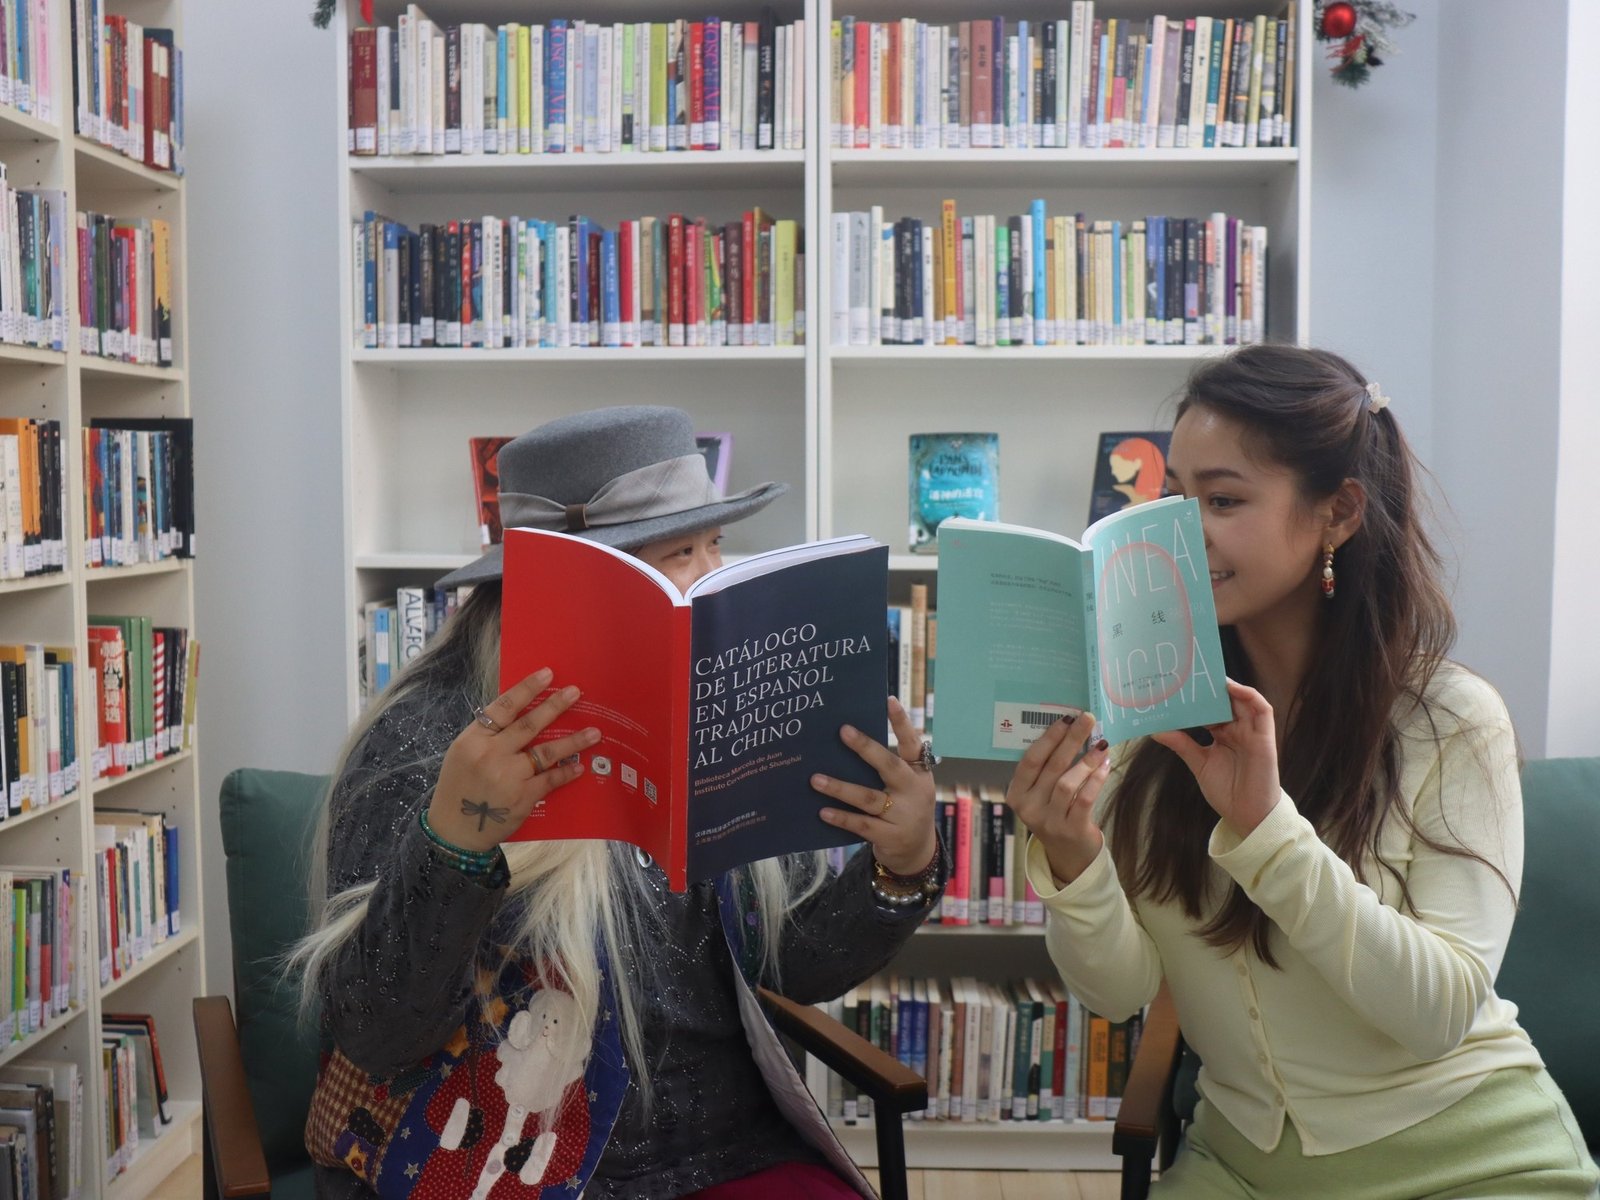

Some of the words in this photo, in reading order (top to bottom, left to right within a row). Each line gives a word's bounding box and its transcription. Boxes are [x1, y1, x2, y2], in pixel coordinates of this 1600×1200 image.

[1099, 518, 1198, 611] INEA
[695, 623, 817, 676] CATÁLOGO
[695, 676, 726, 701] DE
[732, 635, 871, 690] LITERATURA
[694, 690, 825, 746] TRADUCIDA
[695, 699, 727, 724] EN
[735, 666, 834, 713] ESPAÑOL
[694, 747, 723, 769] AL
[731, 718, 802, 757] CHINO
[694, 771, 731, 787] Biblioteca
[767, 751, 783, 761] Juan
[694, 783, 726, 797] Instituto
[726, 769, 758, 786] Cervantes
